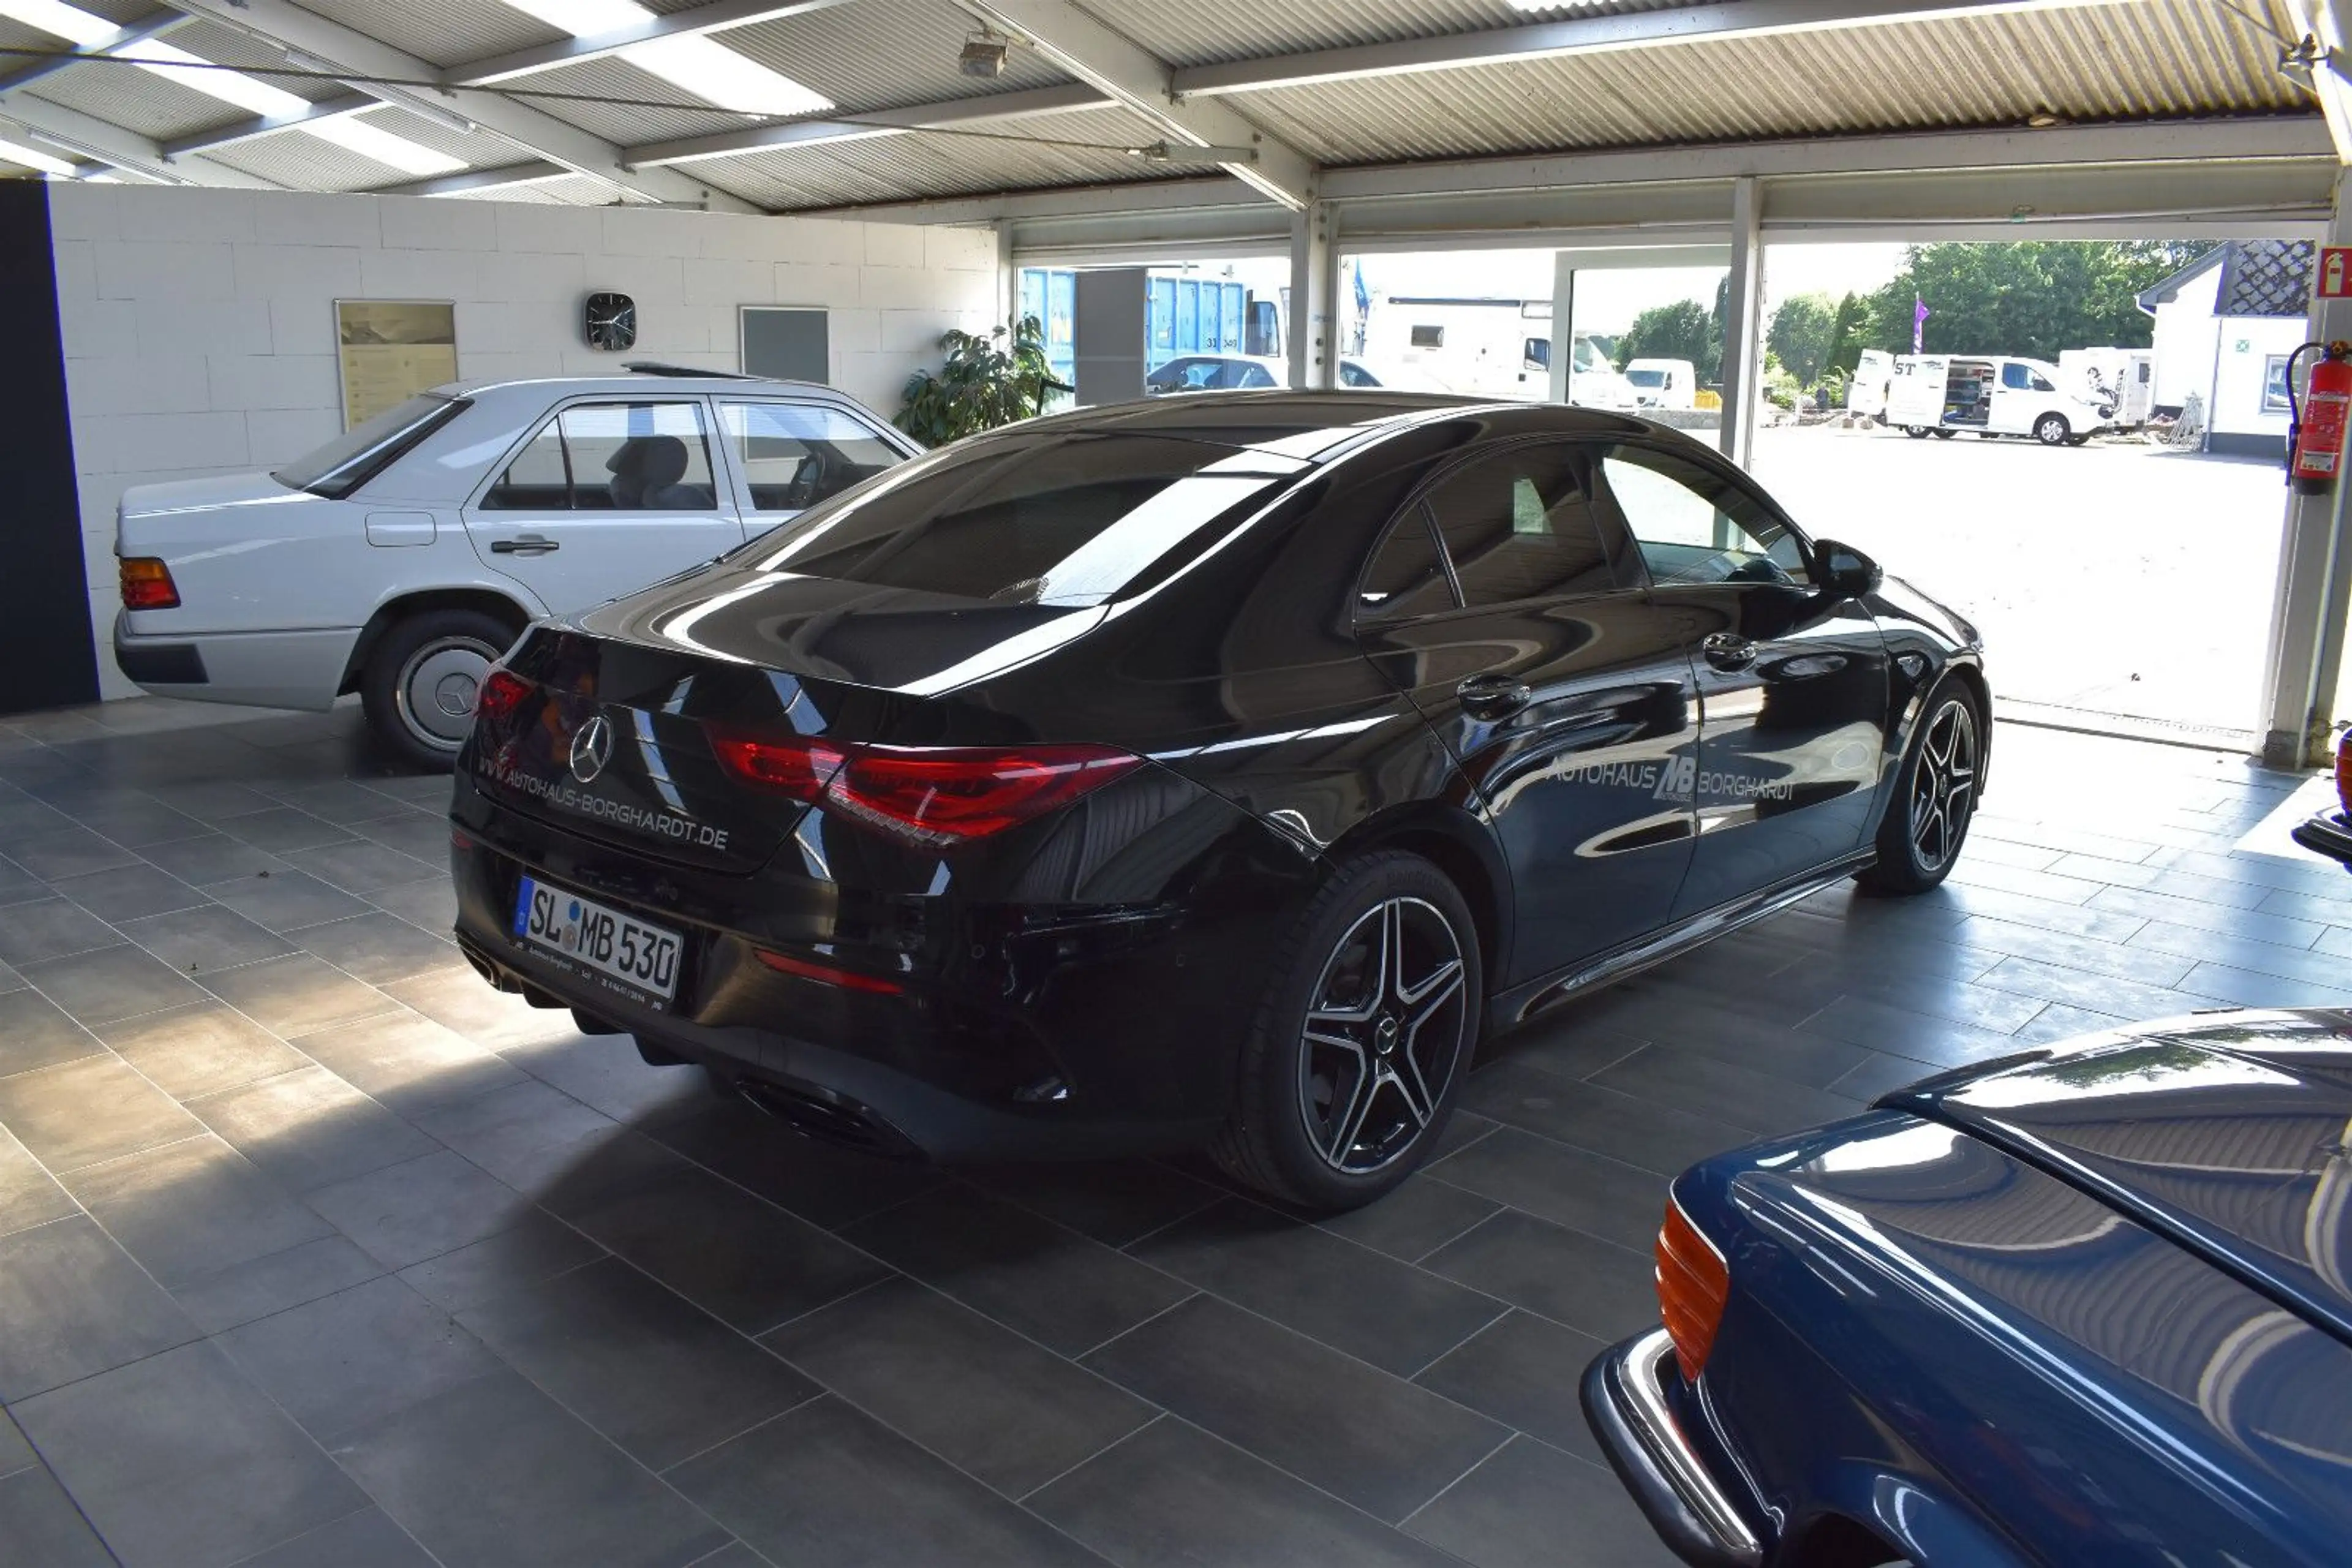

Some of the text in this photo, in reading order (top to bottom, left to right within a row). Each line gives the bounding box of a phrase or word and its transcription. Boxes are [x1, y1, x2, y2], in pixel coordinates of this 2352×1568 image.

[479, 755, 729, 850] WWW.AUTOHAUS-BORGHARDT.DE
[1545, 756, 1656, 789] AUTOHAUS
[1697, 771, 1793, 801] BORGHARDT
[530, 889, 562, 943] SL
[578, 907, 616, 963] MB
[618, 922, 674, 988] 530
